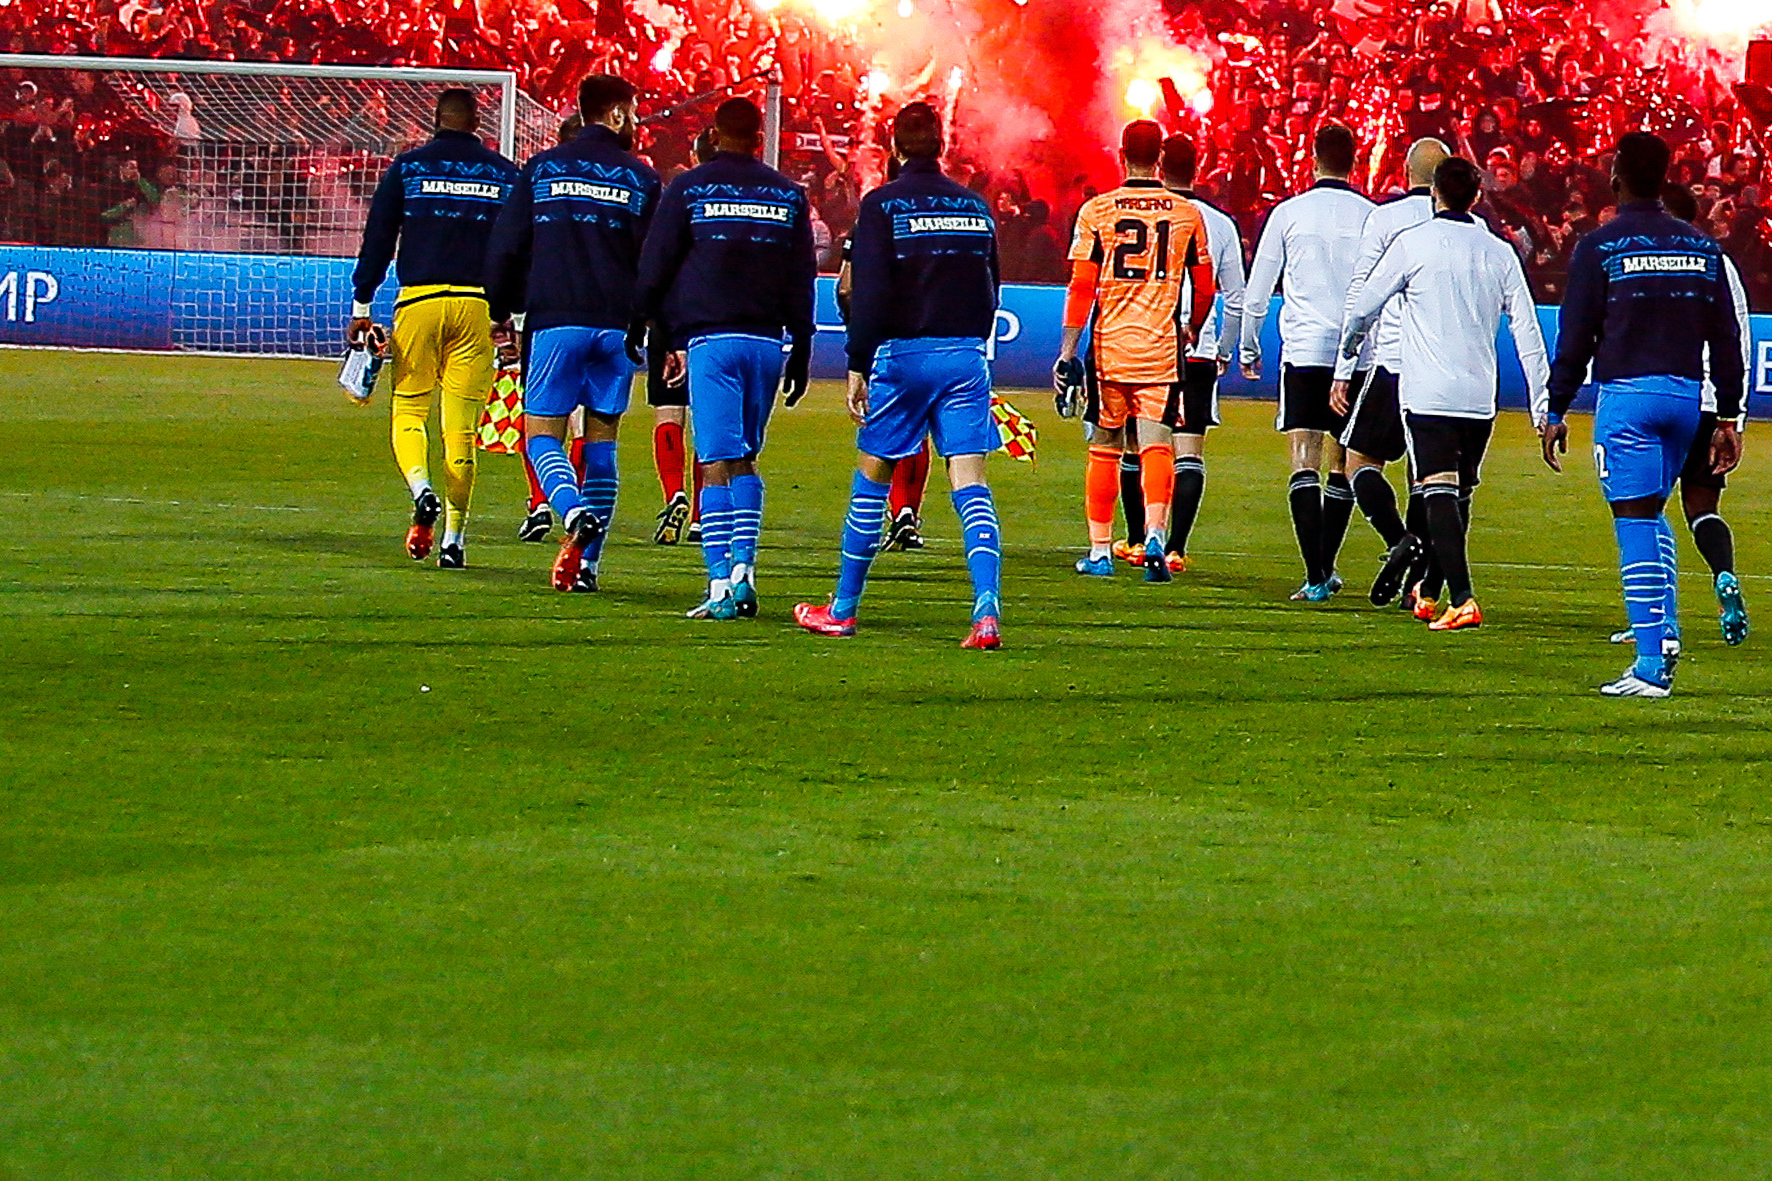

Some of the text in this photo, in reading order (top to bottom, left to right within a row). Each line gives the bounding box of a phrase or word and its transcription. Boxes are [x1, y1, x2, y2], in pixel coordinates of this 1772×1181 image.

[421, 180, 500, 199] MARSEILLE
[550, 182, 630, 204] MARSEILLE
[704, 203, 788, 221] MARSEILLE
[909, 217, 989, 232] MARSEILLE
[1114, 219, 1171, 280] 21
[1623, 256, 1706, 273] MARSEILLE
